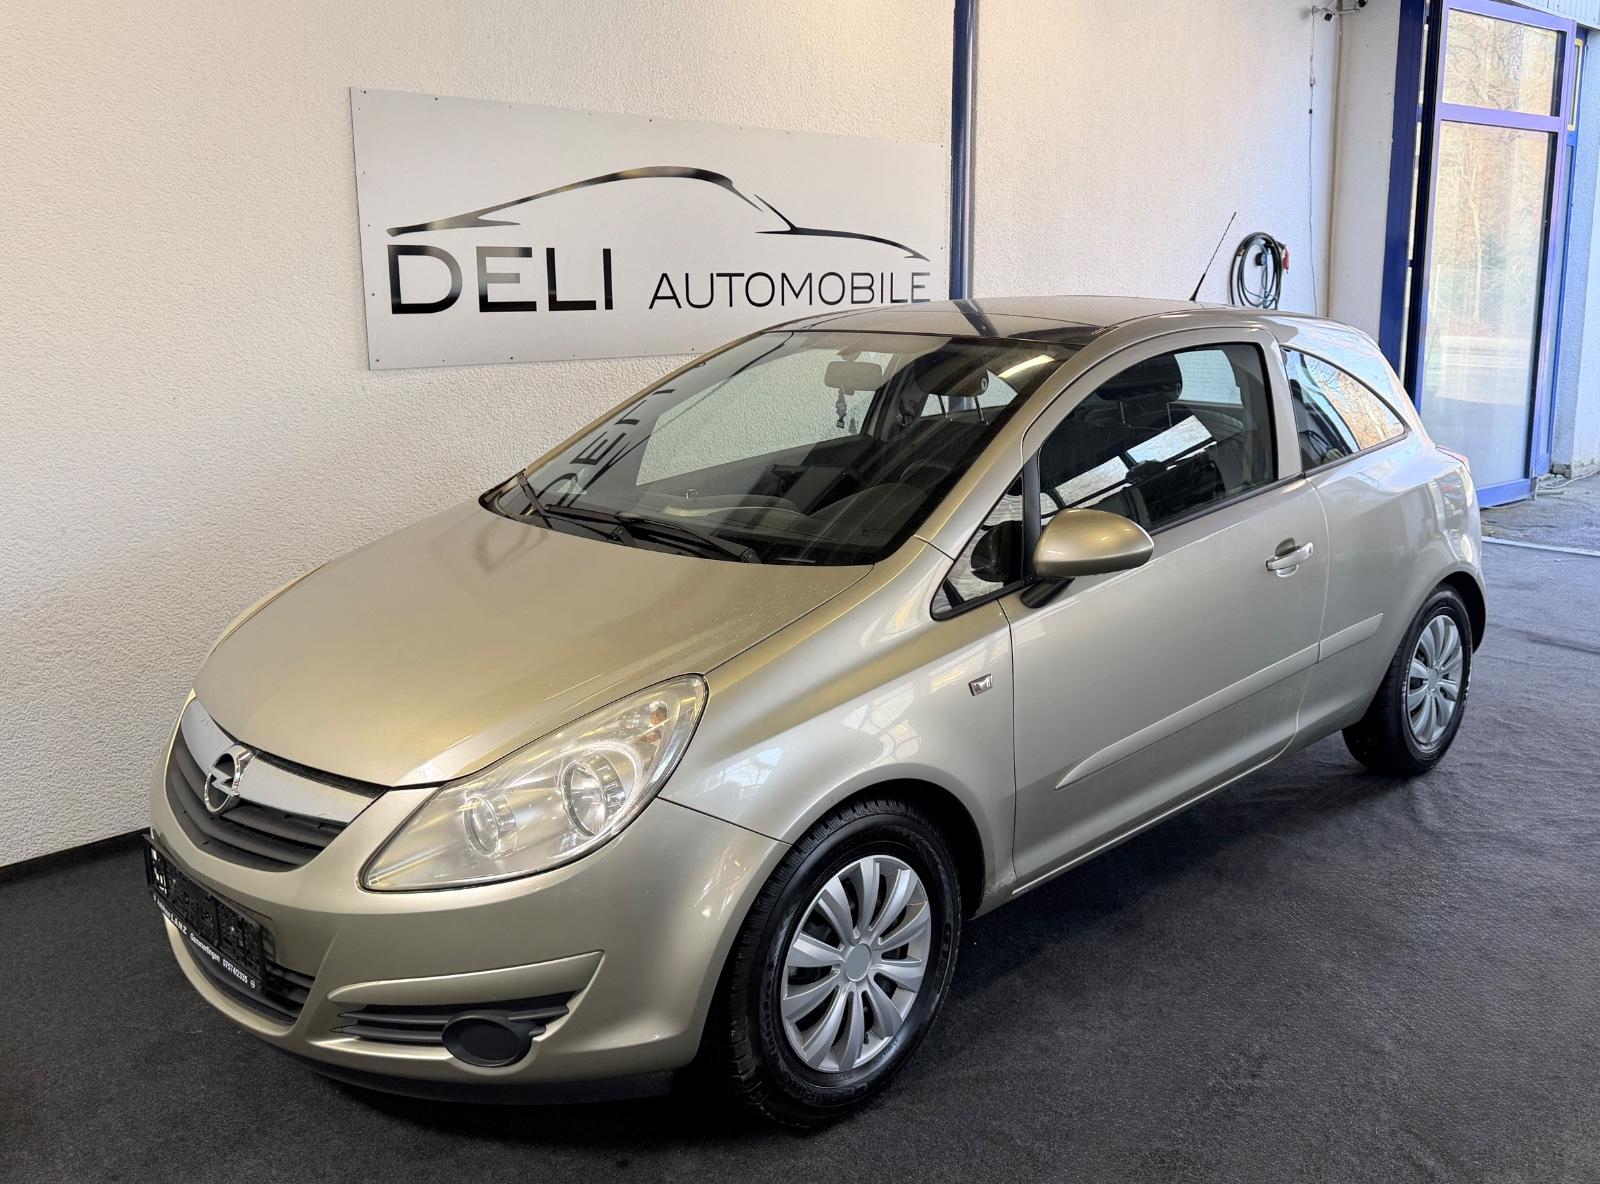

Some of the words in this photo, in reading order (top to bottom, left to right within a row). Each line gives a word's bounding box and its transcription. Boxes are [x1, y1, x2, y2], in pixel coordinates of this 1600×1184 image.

[387, 244, 613, 314] DELI
[648, 272, 931, 309] AUTOMOBILE
[171, 913, 187, 935] LANZ
